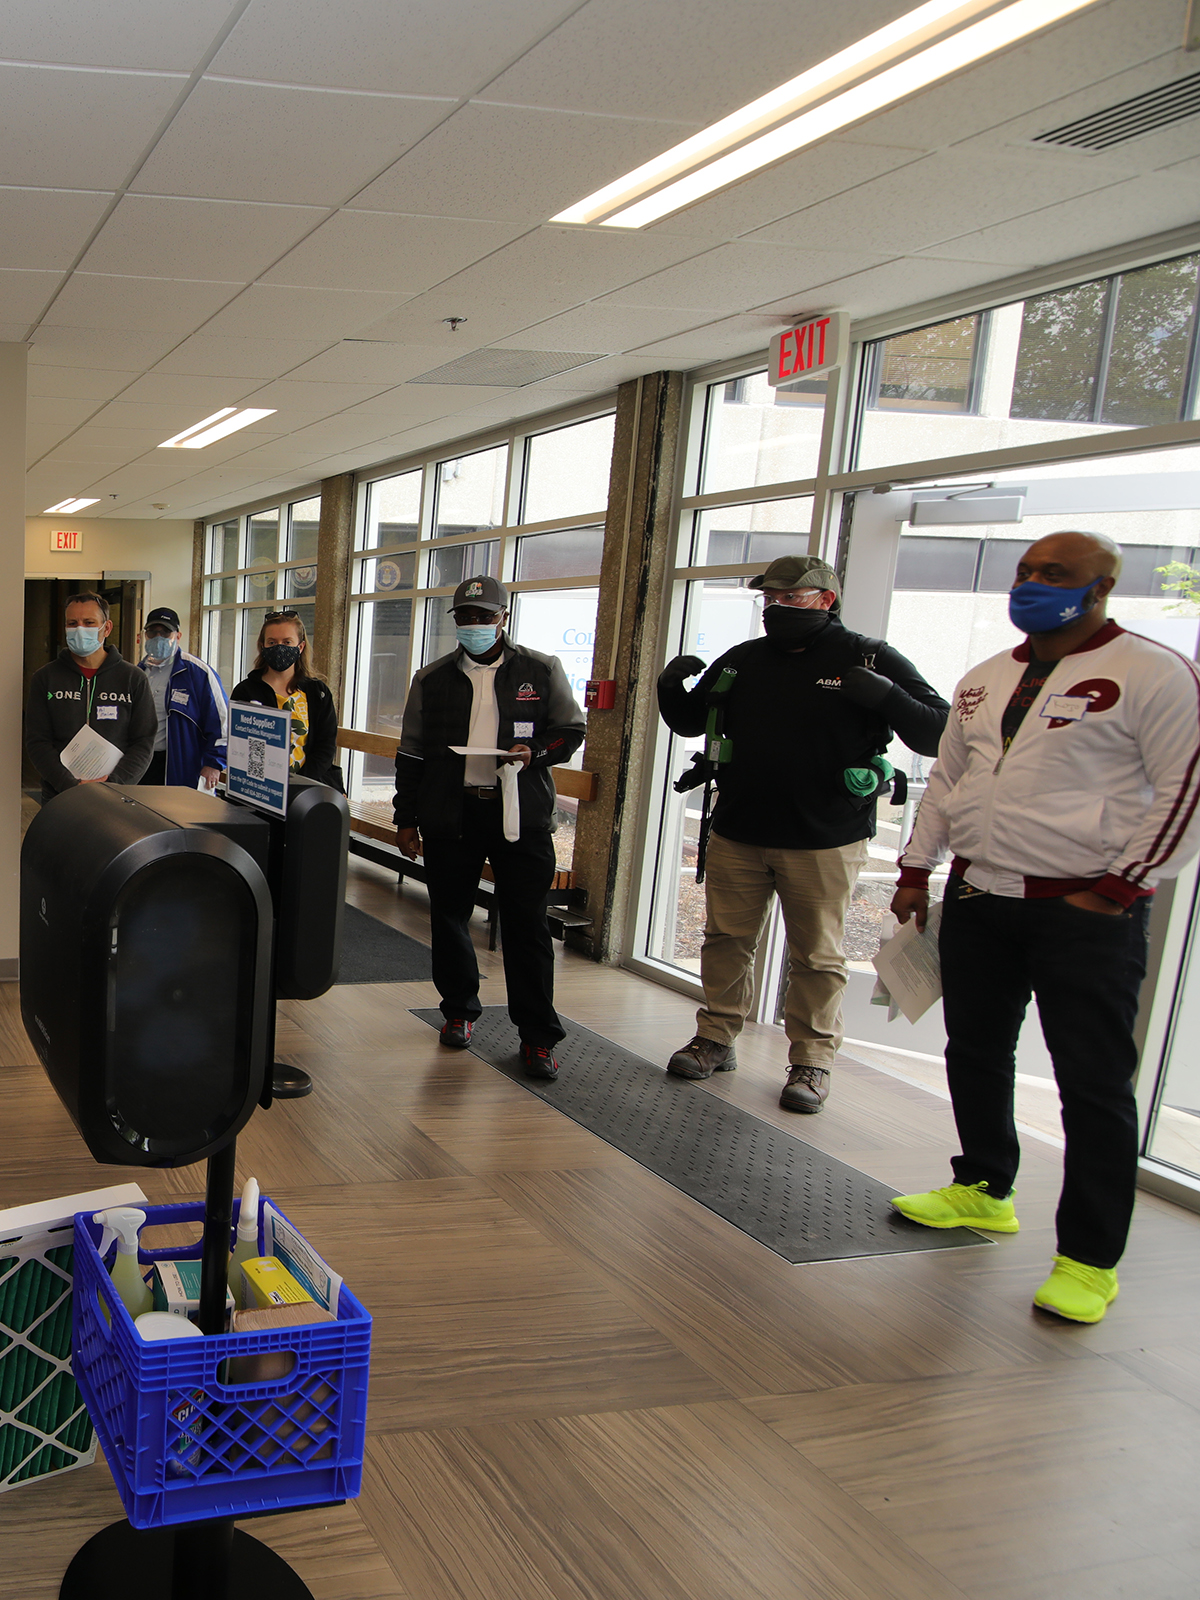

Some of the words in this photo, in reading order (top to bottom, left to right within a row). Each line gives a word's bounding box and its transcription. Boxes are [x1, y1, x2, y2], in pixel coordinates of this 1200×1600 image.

[779, 317, 830, 379] EXIT
[57, 532, 78, 549] EXIT
[815, 678, 842, 686] ABM
[55, 690, 81, 701] ONE
[100, 692, 133, 703] GOAL
[240, 714, 253, 724] Need
[253, 717, 276, 730] Supplies?
